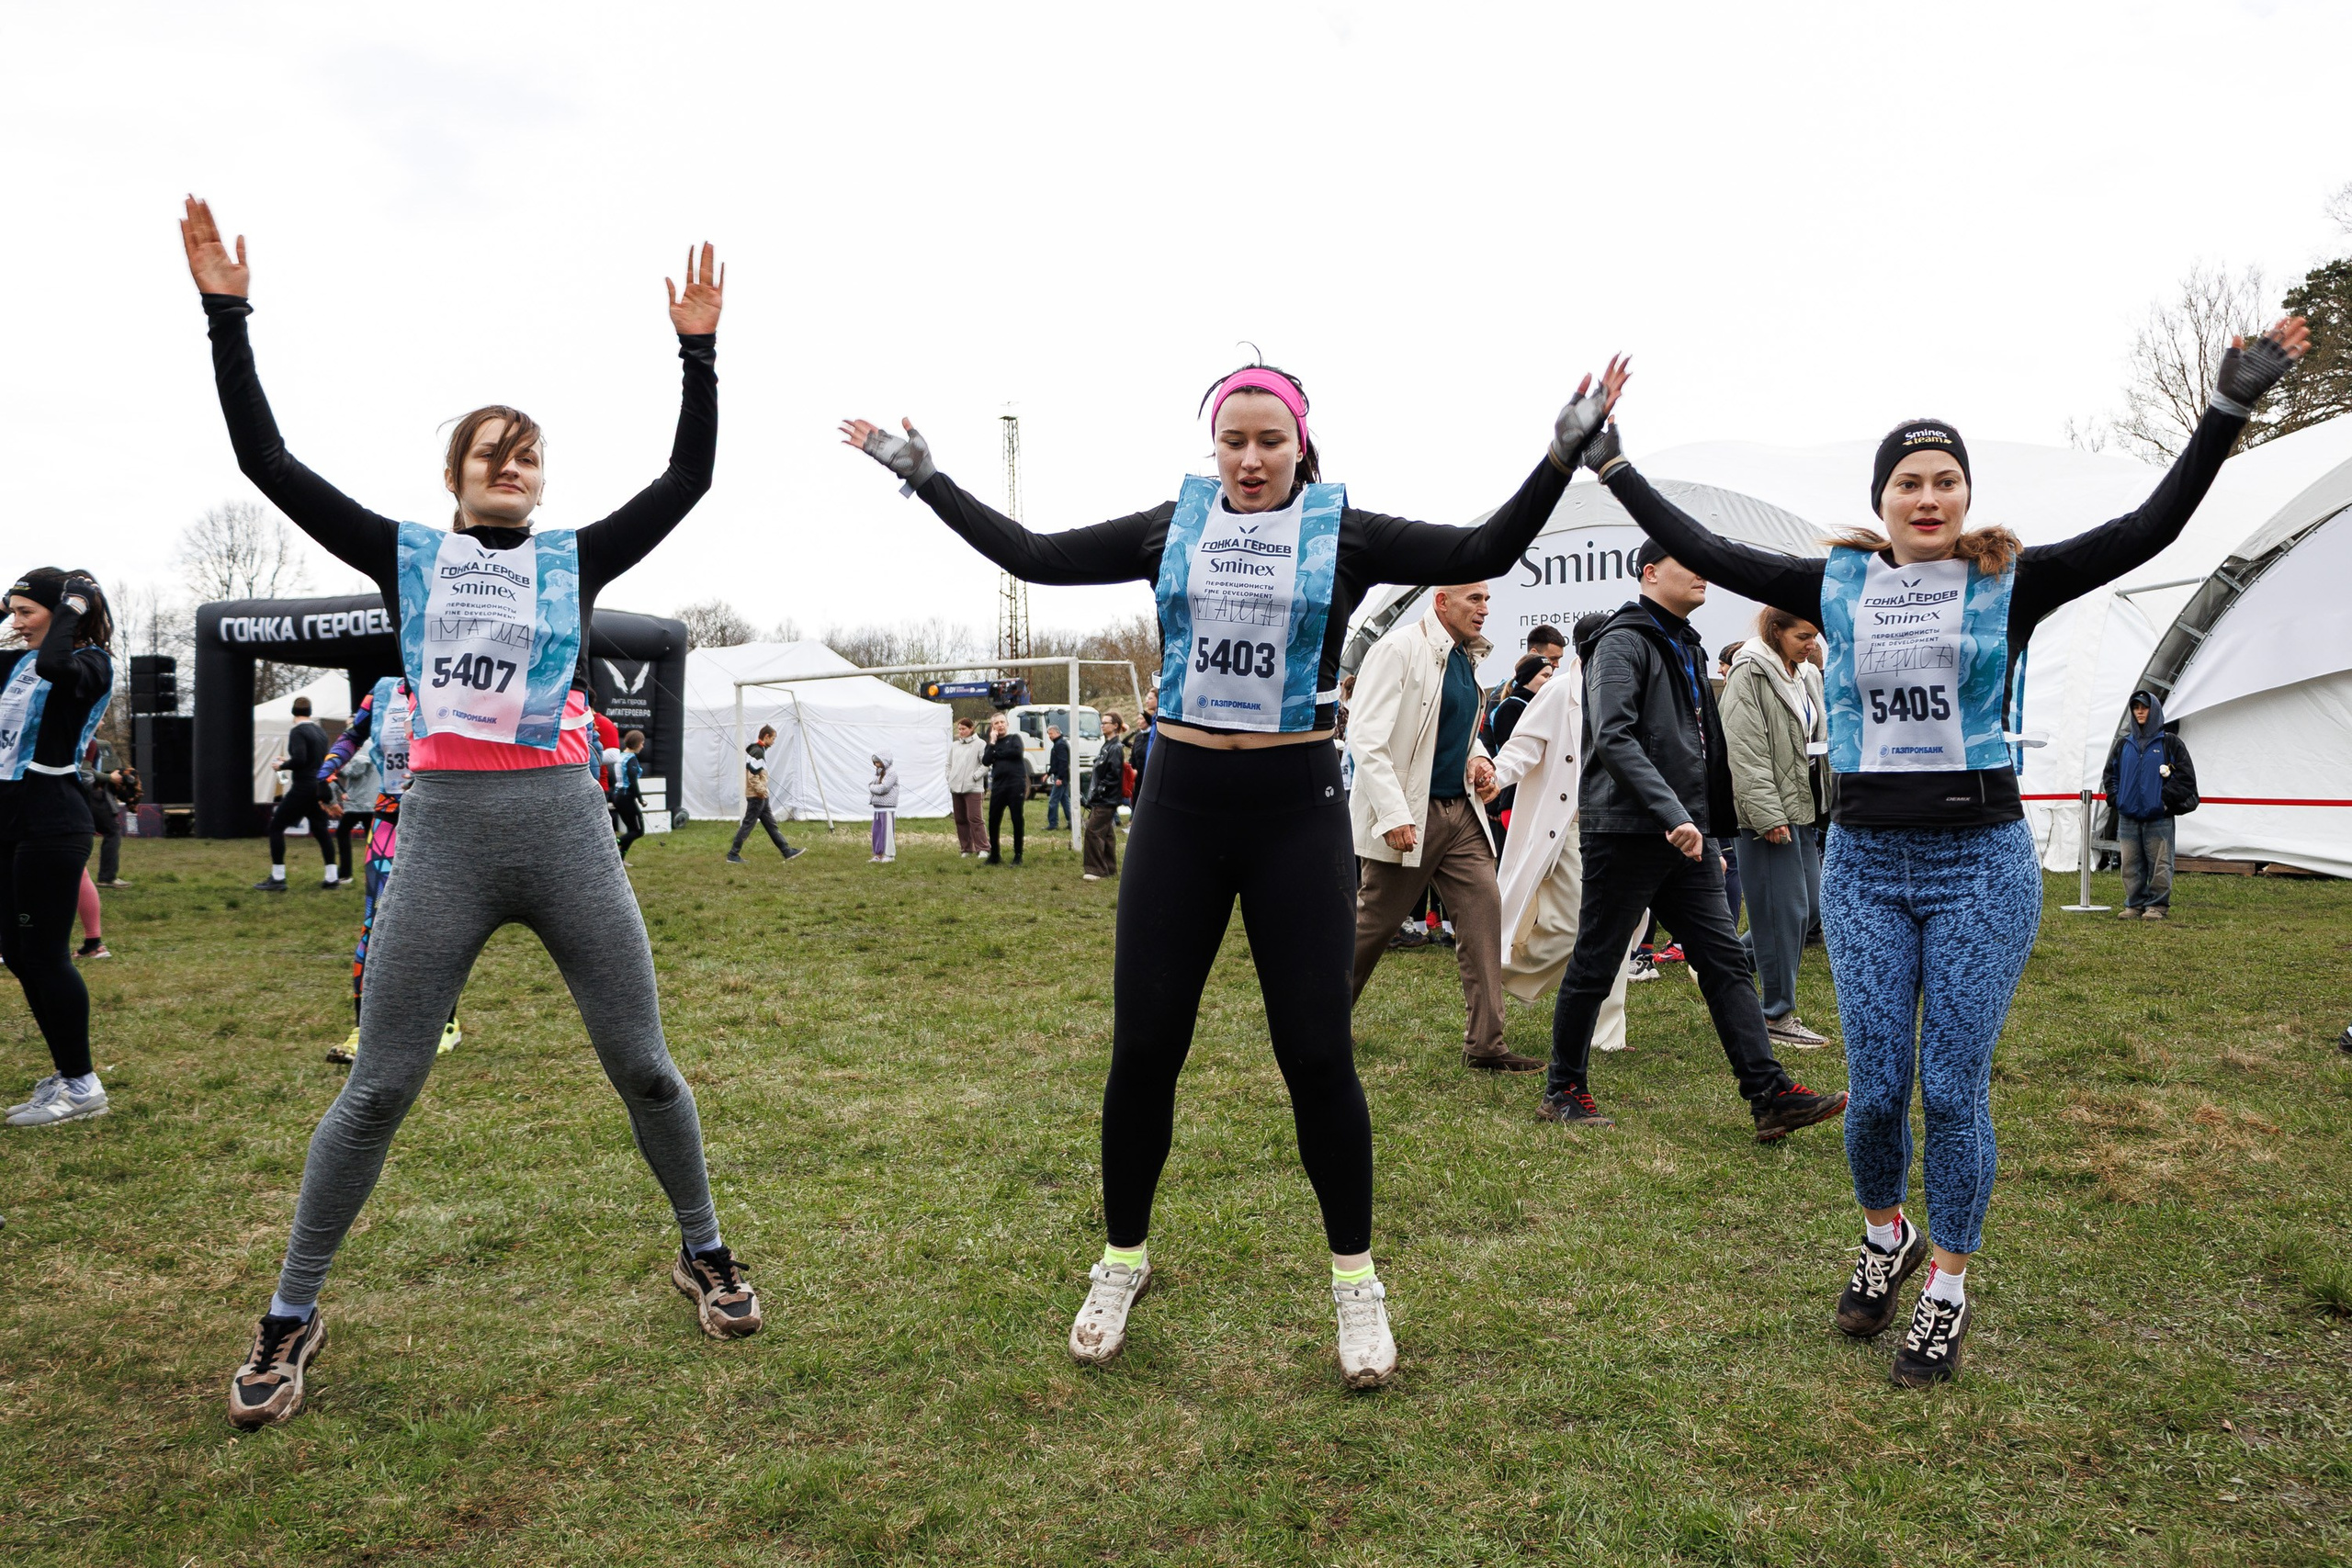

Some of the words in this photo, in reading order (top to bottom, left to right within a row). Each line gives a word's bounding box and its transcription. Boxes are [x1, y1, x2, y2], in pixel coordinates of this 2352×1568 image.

[1905, 429, 1948, 440] Sminex
[1202, 538, 1239, 550] ГОНКА
[1244, 538, 1292, 554] ГЕРОЕВ
[1209, 558, 1275, 577] Sminex
[1520, 540, 1640, 588] Smine
[441, 562, 480, 575] ГОНКА
[485, 563, 530, 585] ГЕРОЕВ
[450, 581, 516, 602] Sminex
[1205, 581, 1274, 591] ПЕРФЕКЦИОНИСТЫ
[1222, 590, 1273, 600] DEVELOPMENT
[1864, 594, 1905, 606] ГОНКА
[1908, 590, 1959, 603] ГЕРОЕВ
[447, 602, 516, 614] ПЕРФЕКЦИОНИСТЫ
[464, 611, 516, 620] DEVELOPMENT
[1873, 610, 1940, 626] Sminex
[220, 616, 299, 642] ГОНКА
[439, 617, 534, 650] МАША
[1871, 628, 1940, 639] ПЕРФЕКЦИОНИСТЫ
[1889, 637, 1939, 647] DEVELOPMENT
[1195, 637, 1276, 679] 5403
[432, 652, 516, 694] 5407
[1210, 699, 1261, 711] ГАЗПРОМБАНК
[1869, 685, 1951, 724] 5405
[0, 729, 18, 750] 54
[1892, 746, 1944, 754] ГАЗПРОМБАНК
